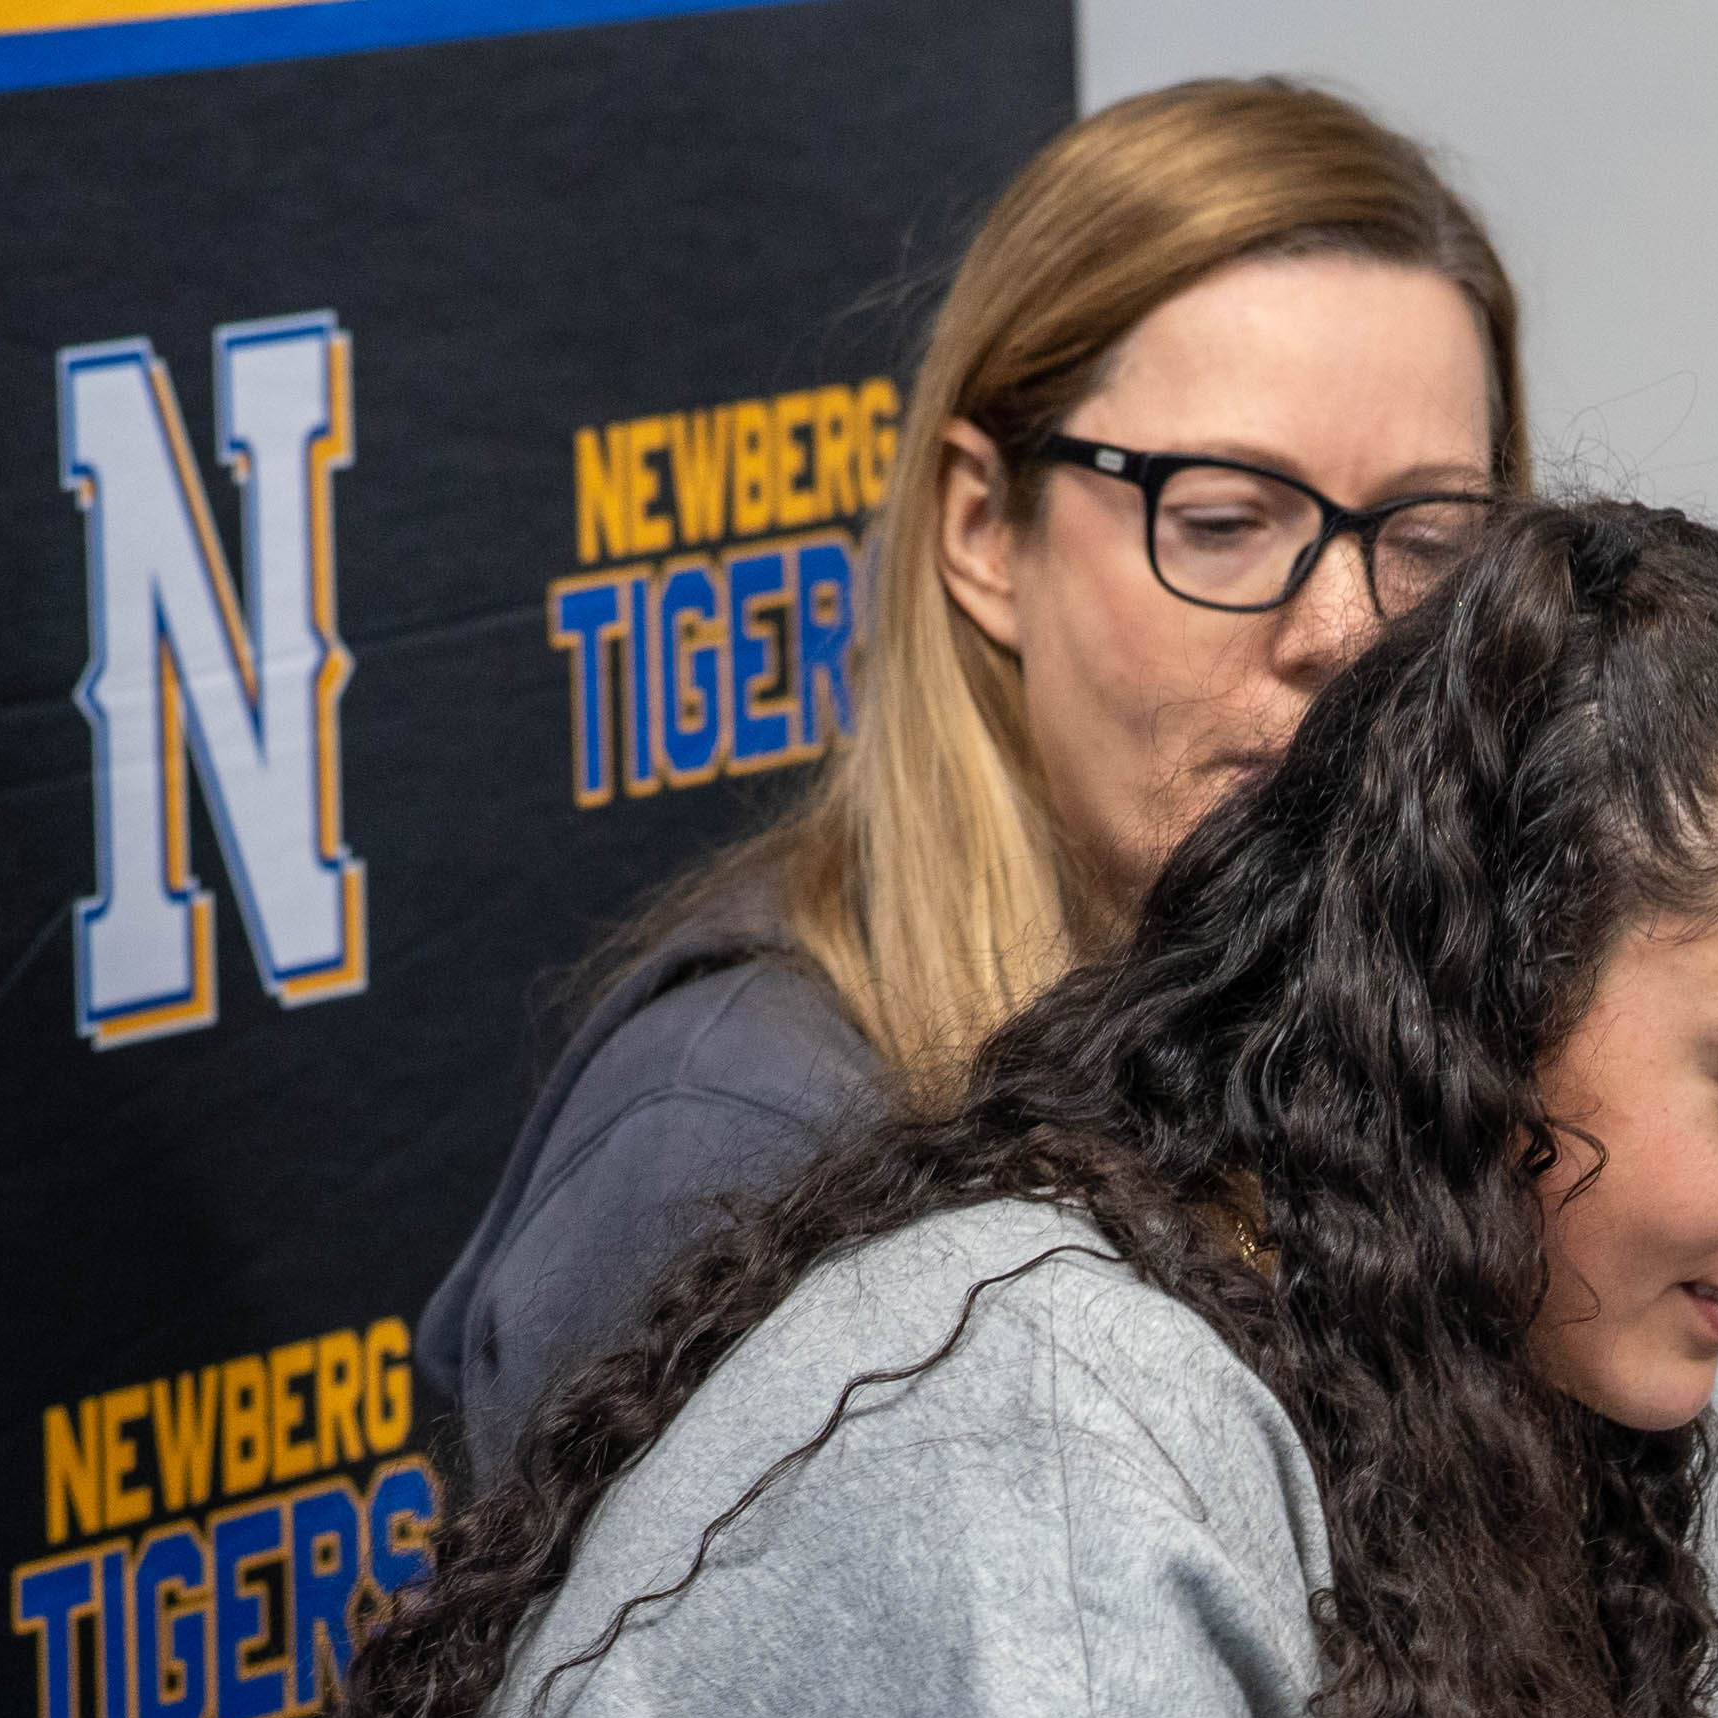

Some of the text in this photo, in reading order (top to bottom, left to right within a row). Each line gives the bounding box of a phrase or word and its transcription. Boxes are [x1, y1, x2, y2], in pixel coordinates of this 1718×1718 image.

[574, 378, 899, 564] NEWBERG
[57, 309, 367, 1051] N
[547, 527, 888, 806] TIGER
[44, 1317, 411, 1544] NEWBERG
